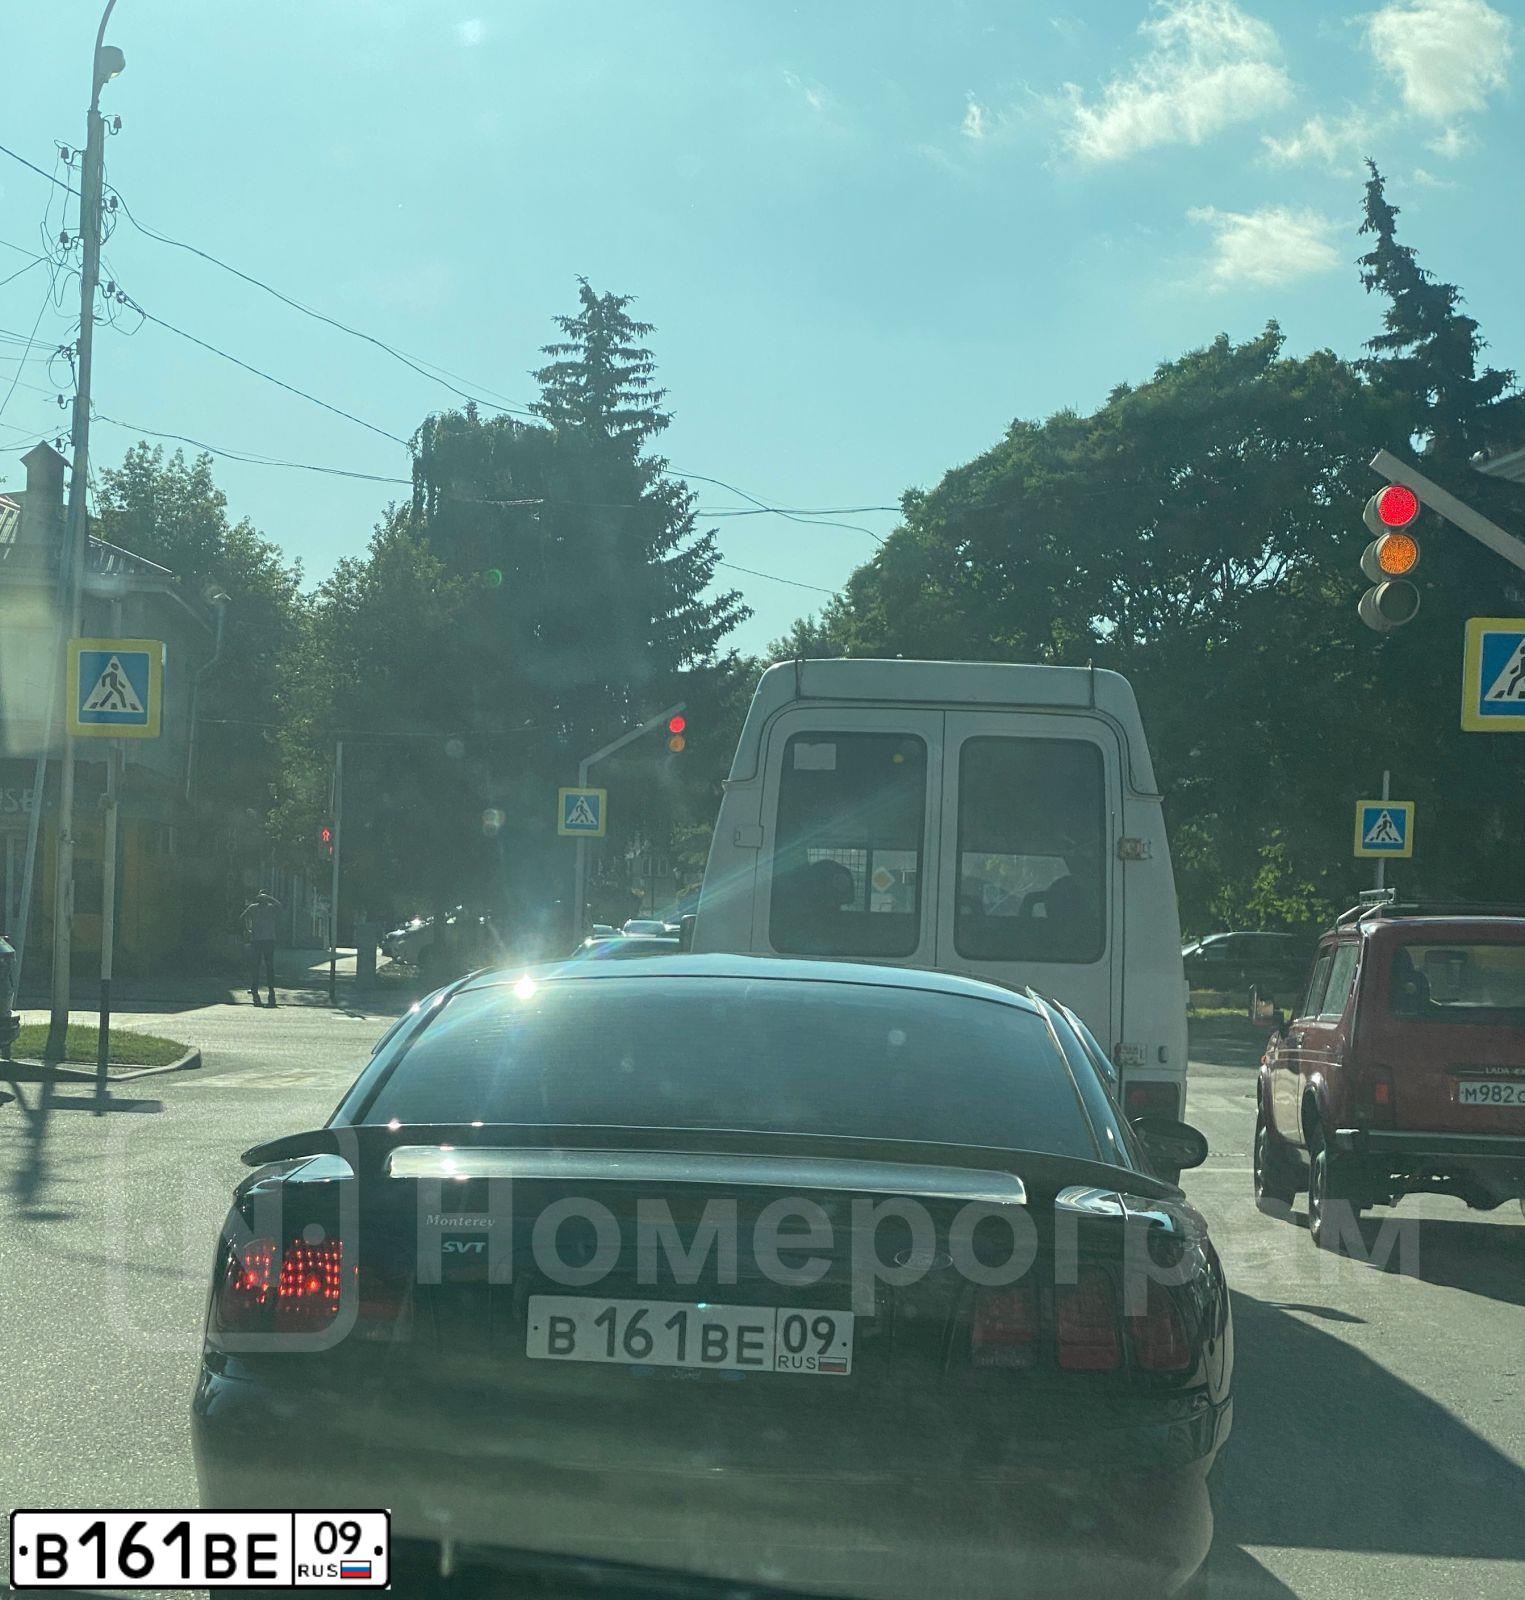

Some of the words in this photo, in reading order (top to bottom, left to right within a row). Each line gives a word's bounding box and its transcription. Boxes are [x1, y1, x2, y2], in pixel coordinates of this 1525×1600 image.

[425, 1214, 495, 1229] Monterey
[441, 1241, 486, 1253] SVT
[783, 1314, 836, 1355] 09
[778, 1355, 816, 1370] RUS
